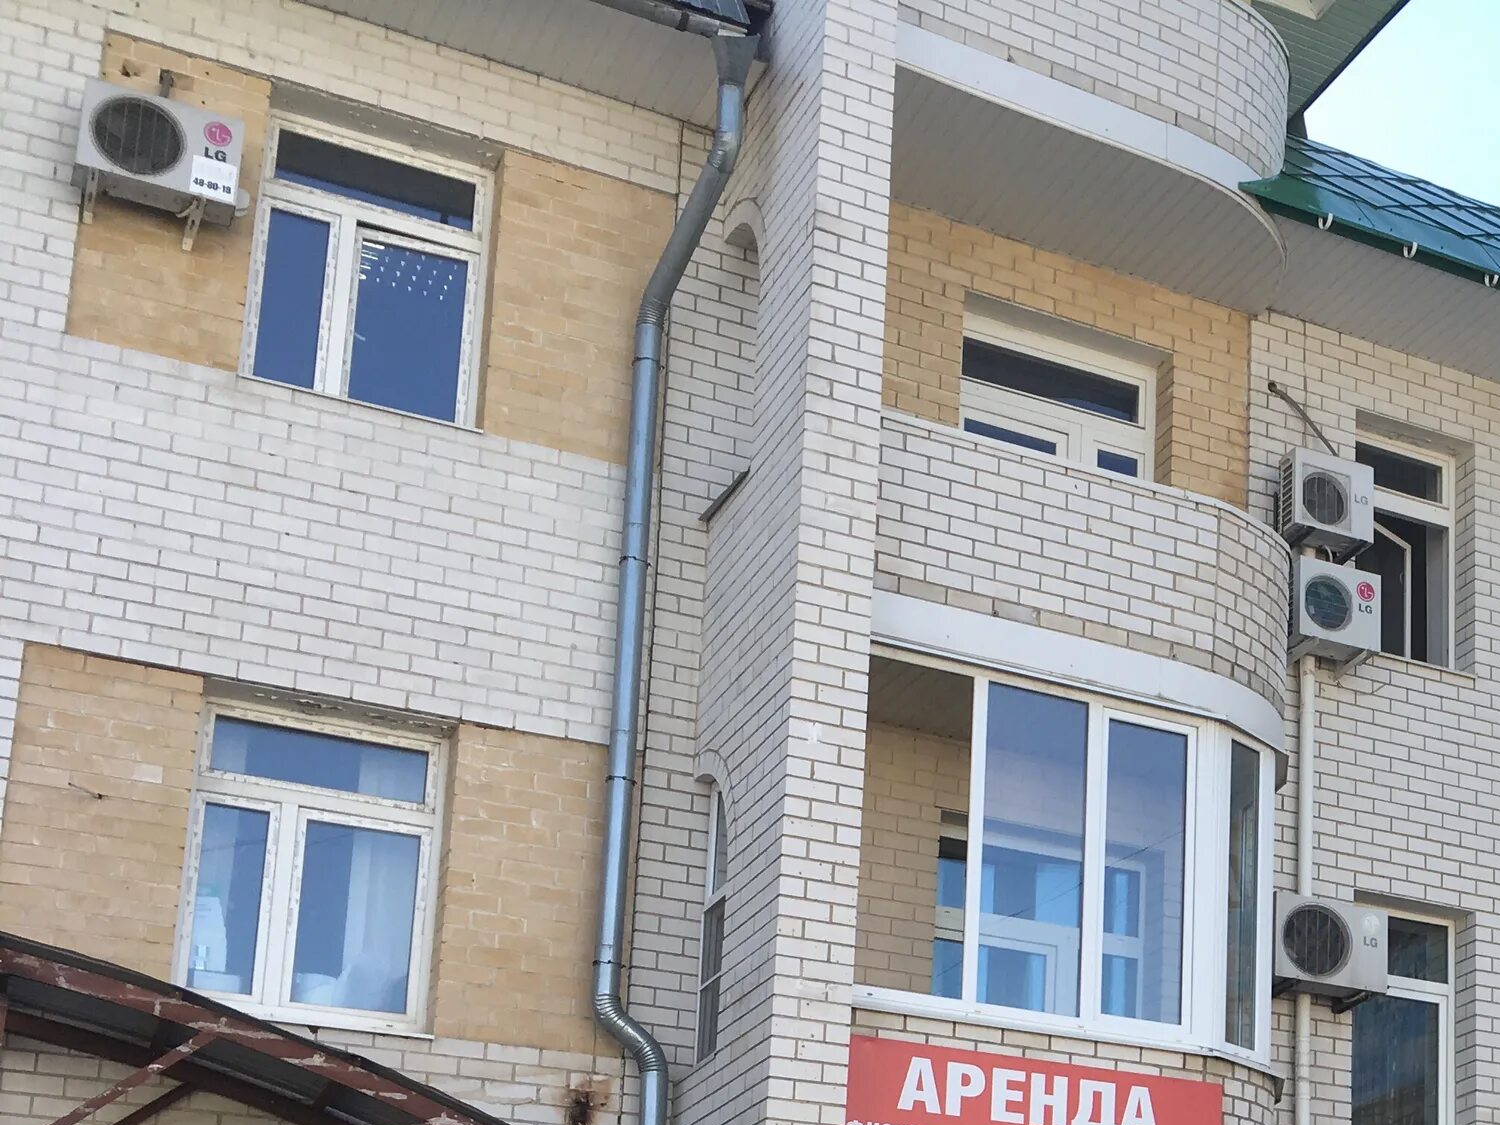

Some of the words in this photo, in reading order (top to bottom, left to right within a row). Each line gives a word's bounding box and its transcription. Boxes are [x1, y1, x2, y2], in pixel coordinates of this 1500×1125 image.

[204, 146, 227, 162] LG
[1354, 494, 1368, 505] LG
[1358, 603, 1372, 614] LG
[1363, 935, 1378, 948] LG
